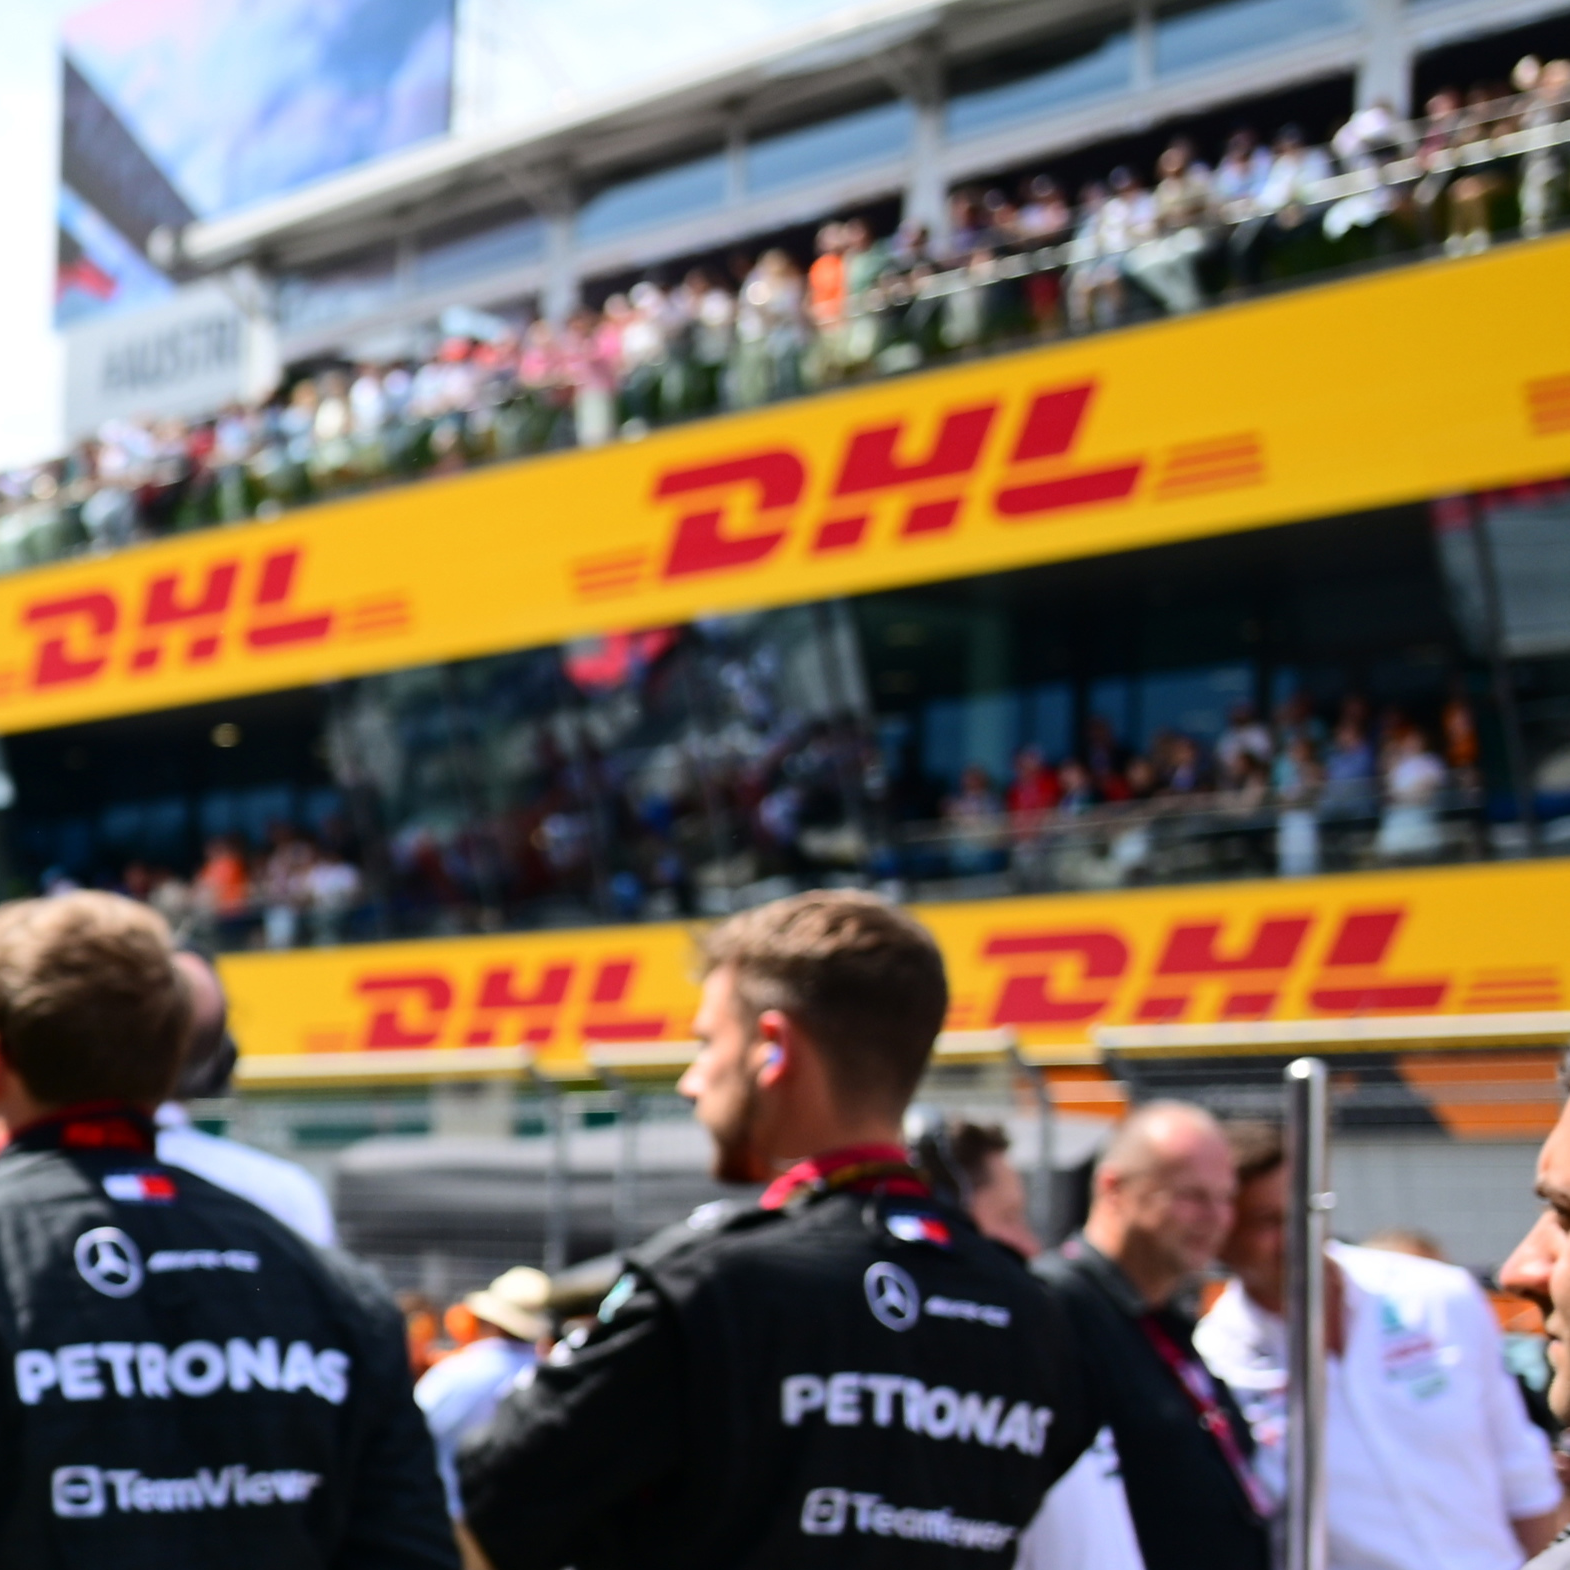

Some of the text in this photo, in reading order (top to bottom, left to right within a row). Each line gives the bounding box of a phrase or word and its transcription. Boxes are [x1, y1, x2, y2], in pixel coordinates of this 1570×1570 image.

[649, 376, 1149, 583] DHL
[18, 546, 334, 692] DHL
[355, 958, 668, 1050] DHL
[980, 904, 1451, 1026] DHL
[14, 1336, 351, 1405] PETRONAS
